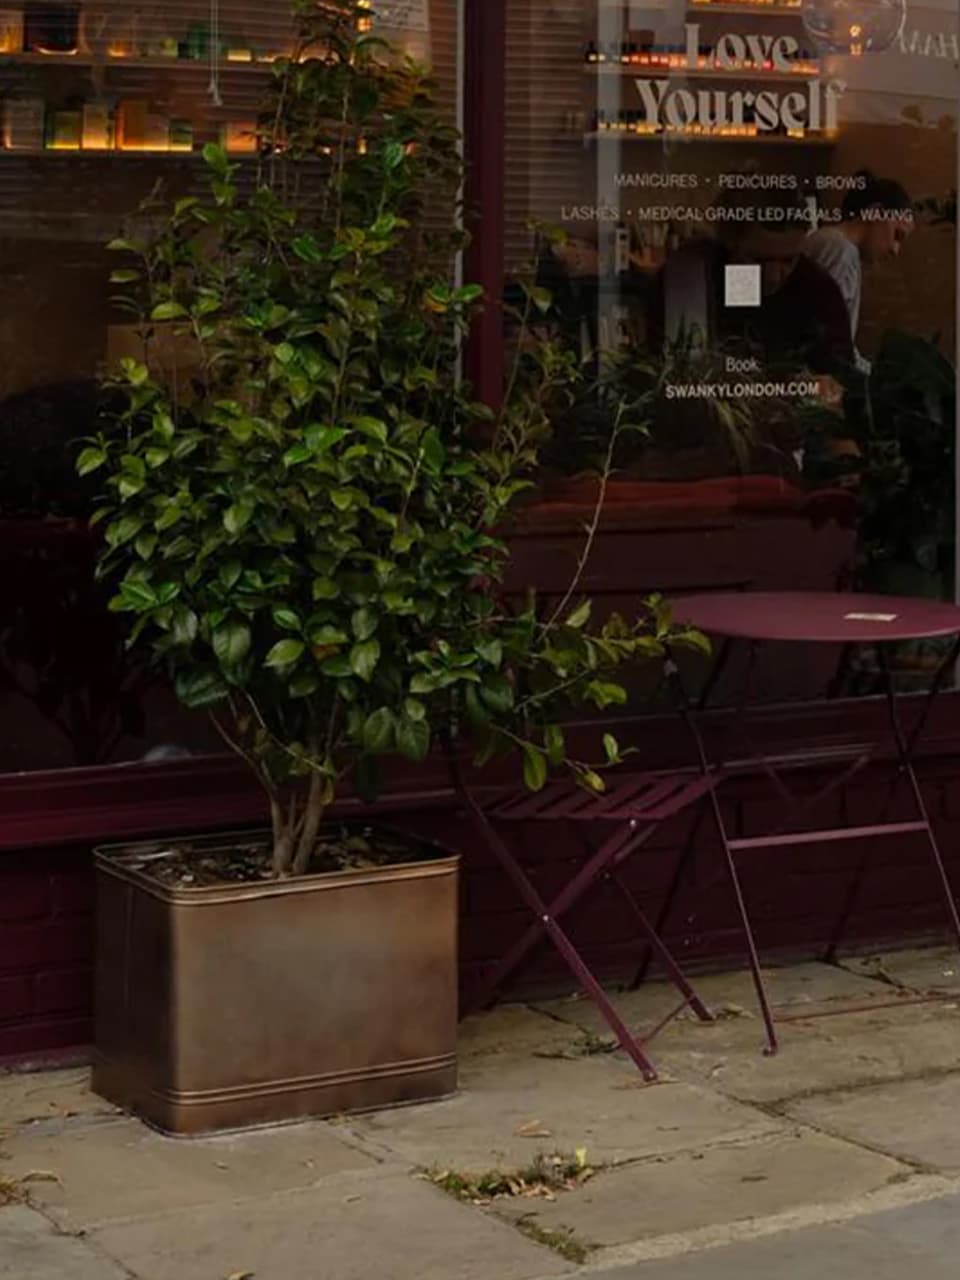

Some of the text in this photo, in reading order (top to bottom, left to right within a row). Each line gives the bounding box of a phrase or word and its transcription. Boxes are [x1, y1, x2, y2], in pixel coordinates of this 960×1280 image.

[685, 23, 799, 71] Love
[634, 78, 848, 132] Yourself
[613, 173, 867, 190] MANICURES PEDICURES BROWS
[561, 205, 913, 222] LASHES MEDICAL GRADE LED FACIALS WAXING
[665, 381, 819, 399] SWANKYLONDON.COM
